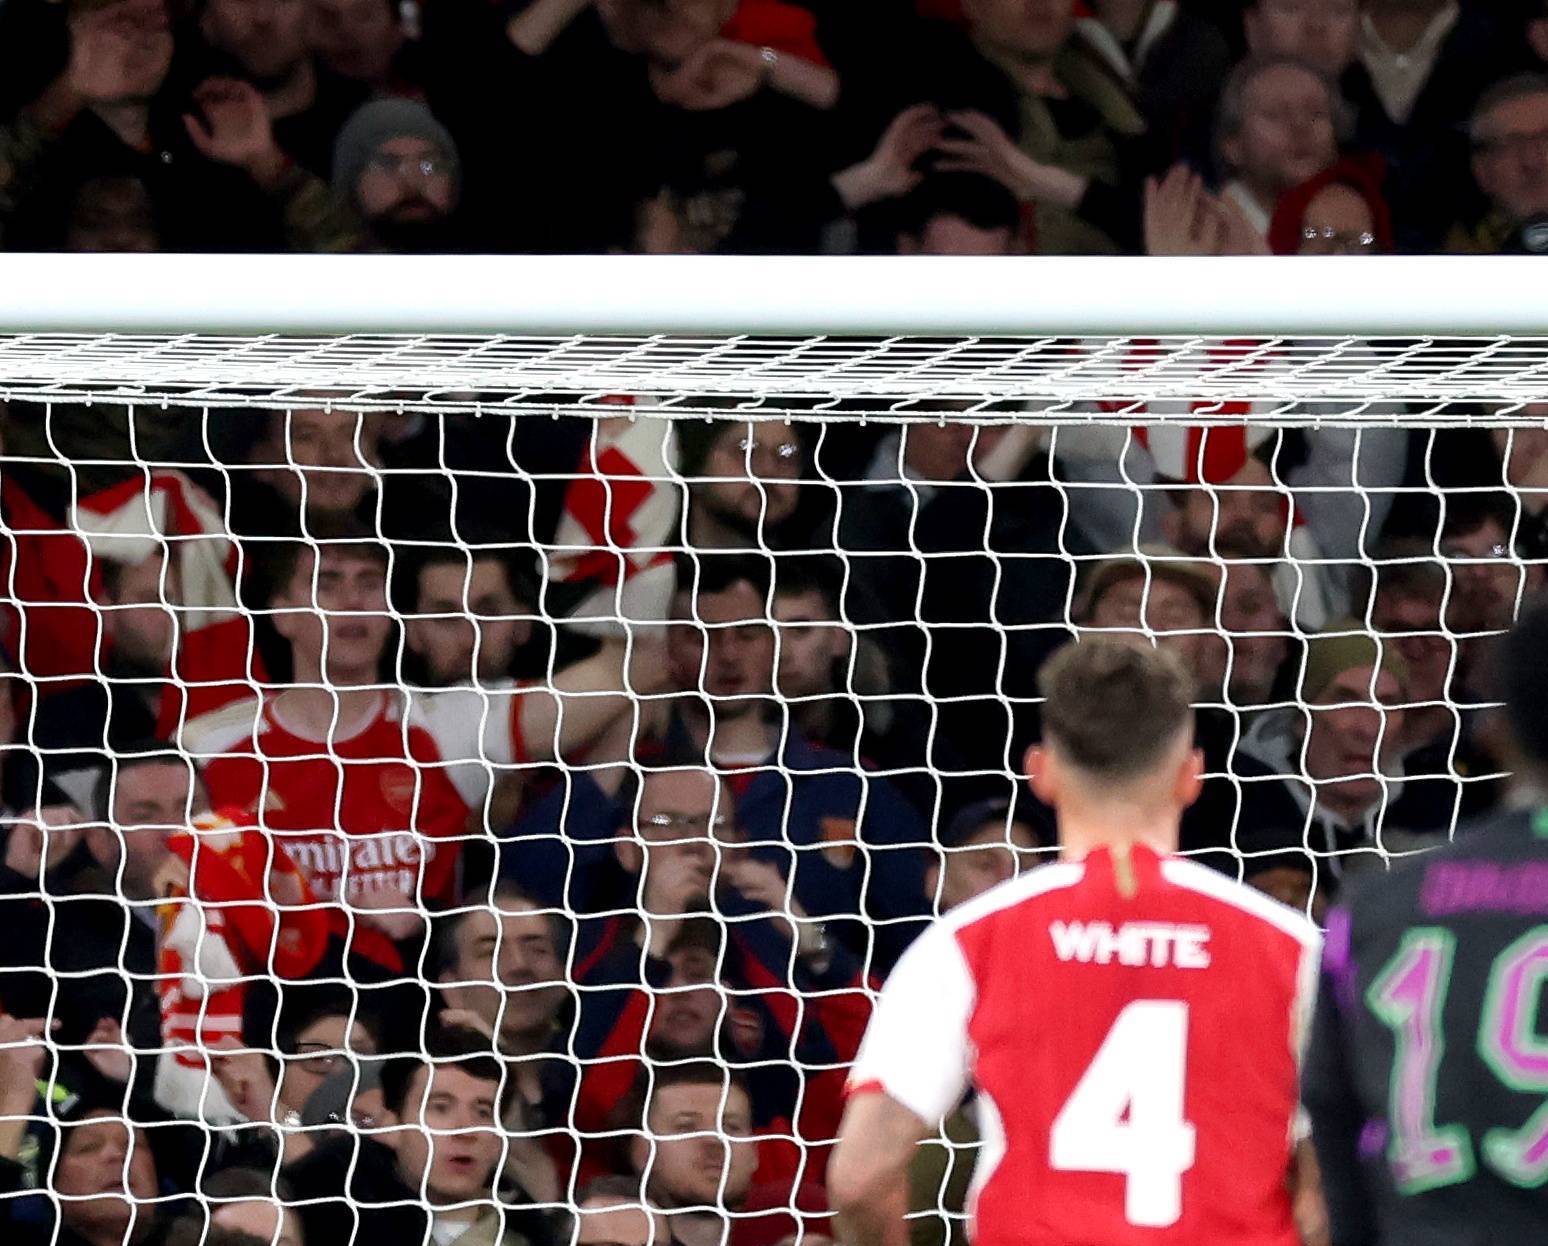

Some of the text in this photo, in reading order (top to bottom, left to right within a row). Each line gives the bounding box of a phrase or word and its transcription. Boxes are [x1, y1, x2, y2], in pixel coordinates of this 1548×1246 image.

[284, 832, 437, 873] mirates
[1048, 919, 1212, 969] WHITE
[1048, 999, 1197, 1228] 4
